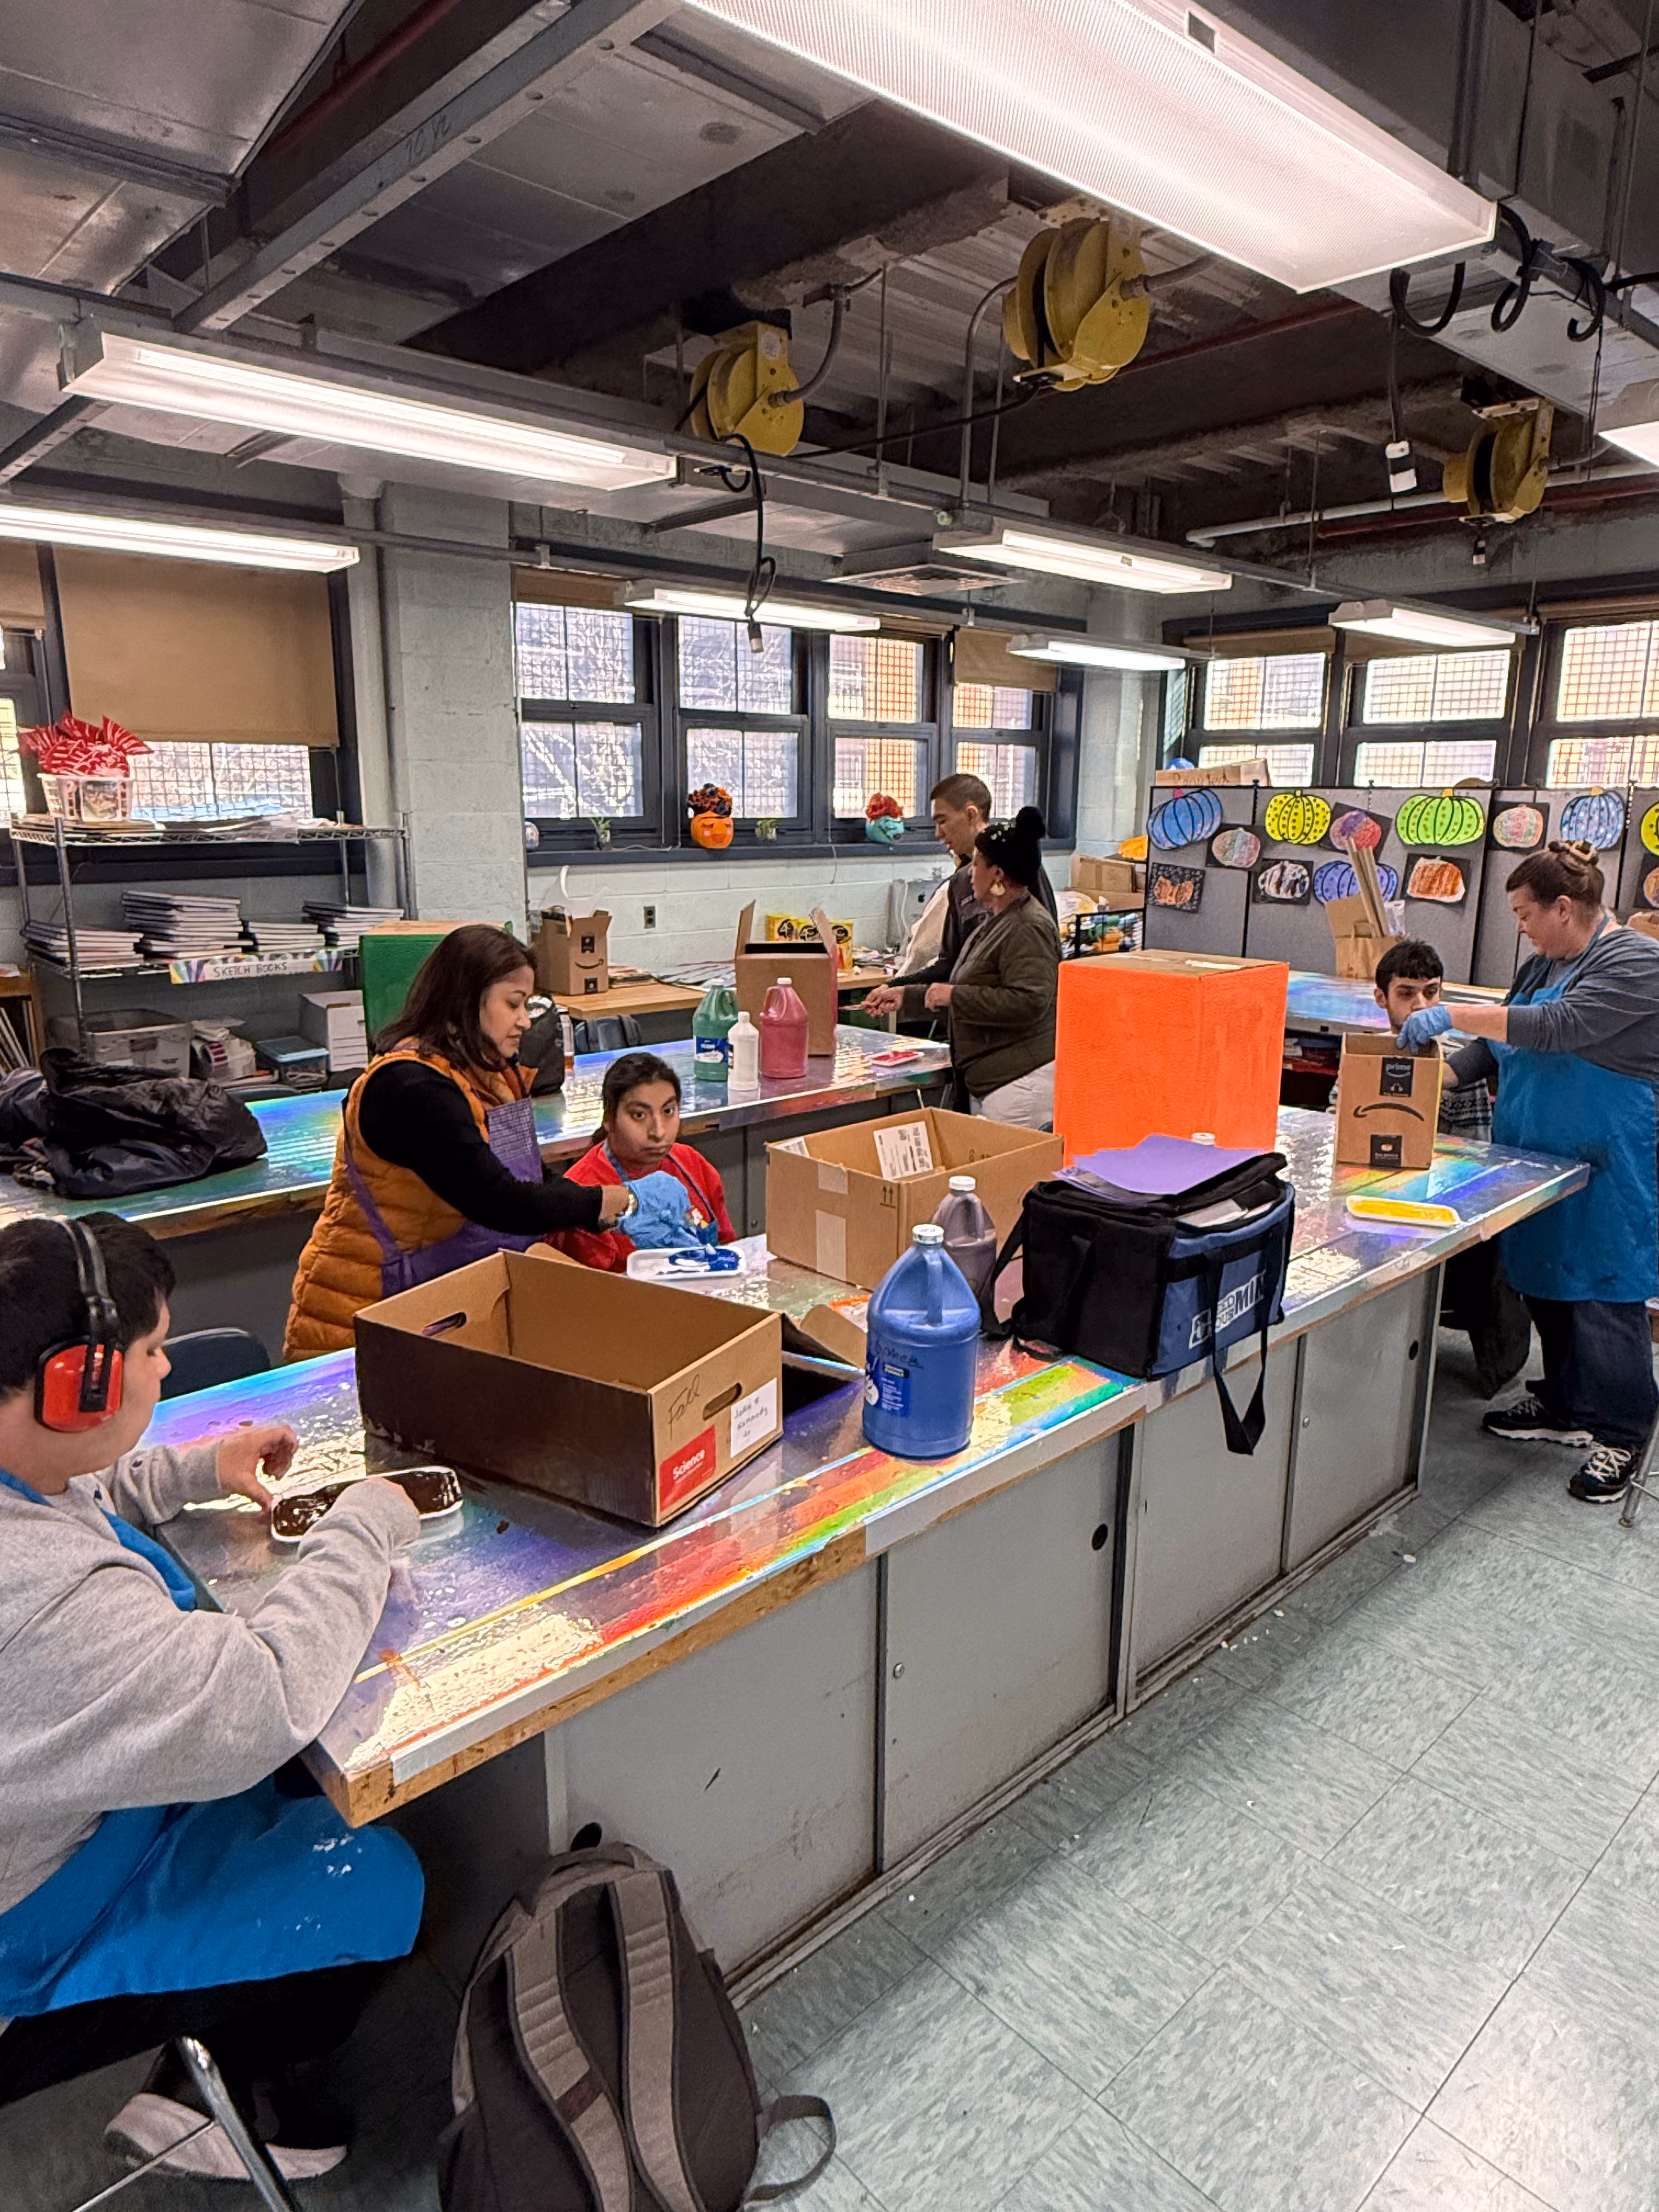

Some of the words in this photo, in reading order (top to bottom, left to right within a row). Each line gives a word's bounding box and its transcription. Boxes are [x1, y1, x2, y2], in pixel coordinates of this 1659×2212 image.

[213, 965, 250, 977] SKETCH
[256, 961, 287, 974] BOOKS
[1385, 1062, 1411, 1071] prime
[673, 1449, 705, 1480] Science
